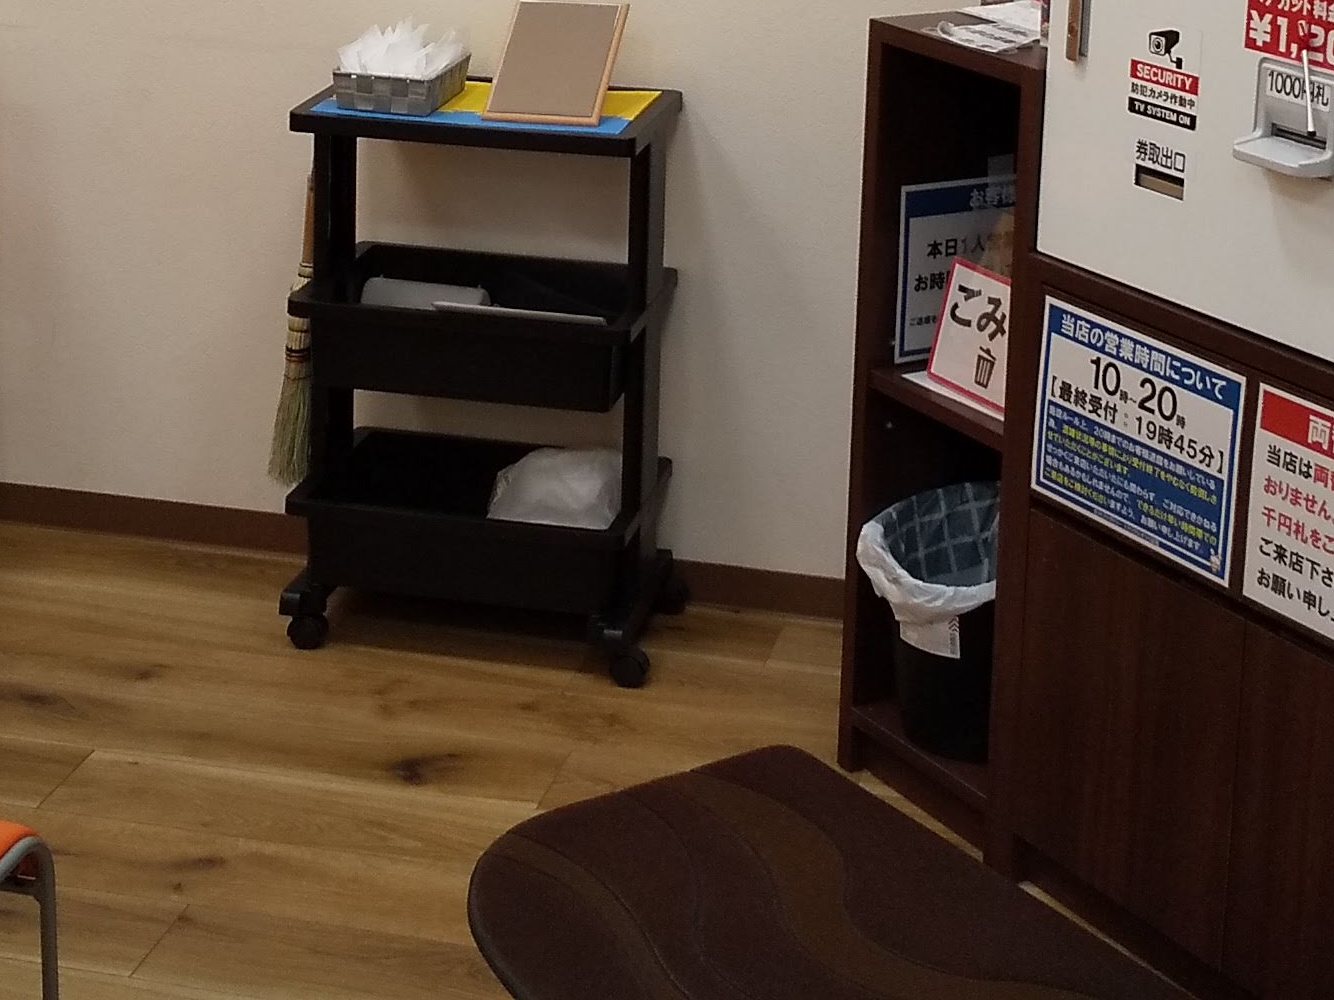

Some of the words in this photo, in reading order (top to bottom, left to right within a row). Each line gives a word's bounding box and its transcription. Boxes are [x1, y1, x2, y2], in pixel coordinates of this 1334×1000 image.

[1136, 63, 1193, 91] SECURITY
[1131, 82, 1196, 110] 防犯カメラ作動中
[1134, 100, 1145, 113] TV
[1147, 104, 1178, 122] SYSTEM
[1178, 114, 1191, 127] ON
[1136, 138, 1186, 174] 券取出口
[950, 284, 1007, 342] ごみ
[1061, 314, 1227, 400] 当店の営業時間について
